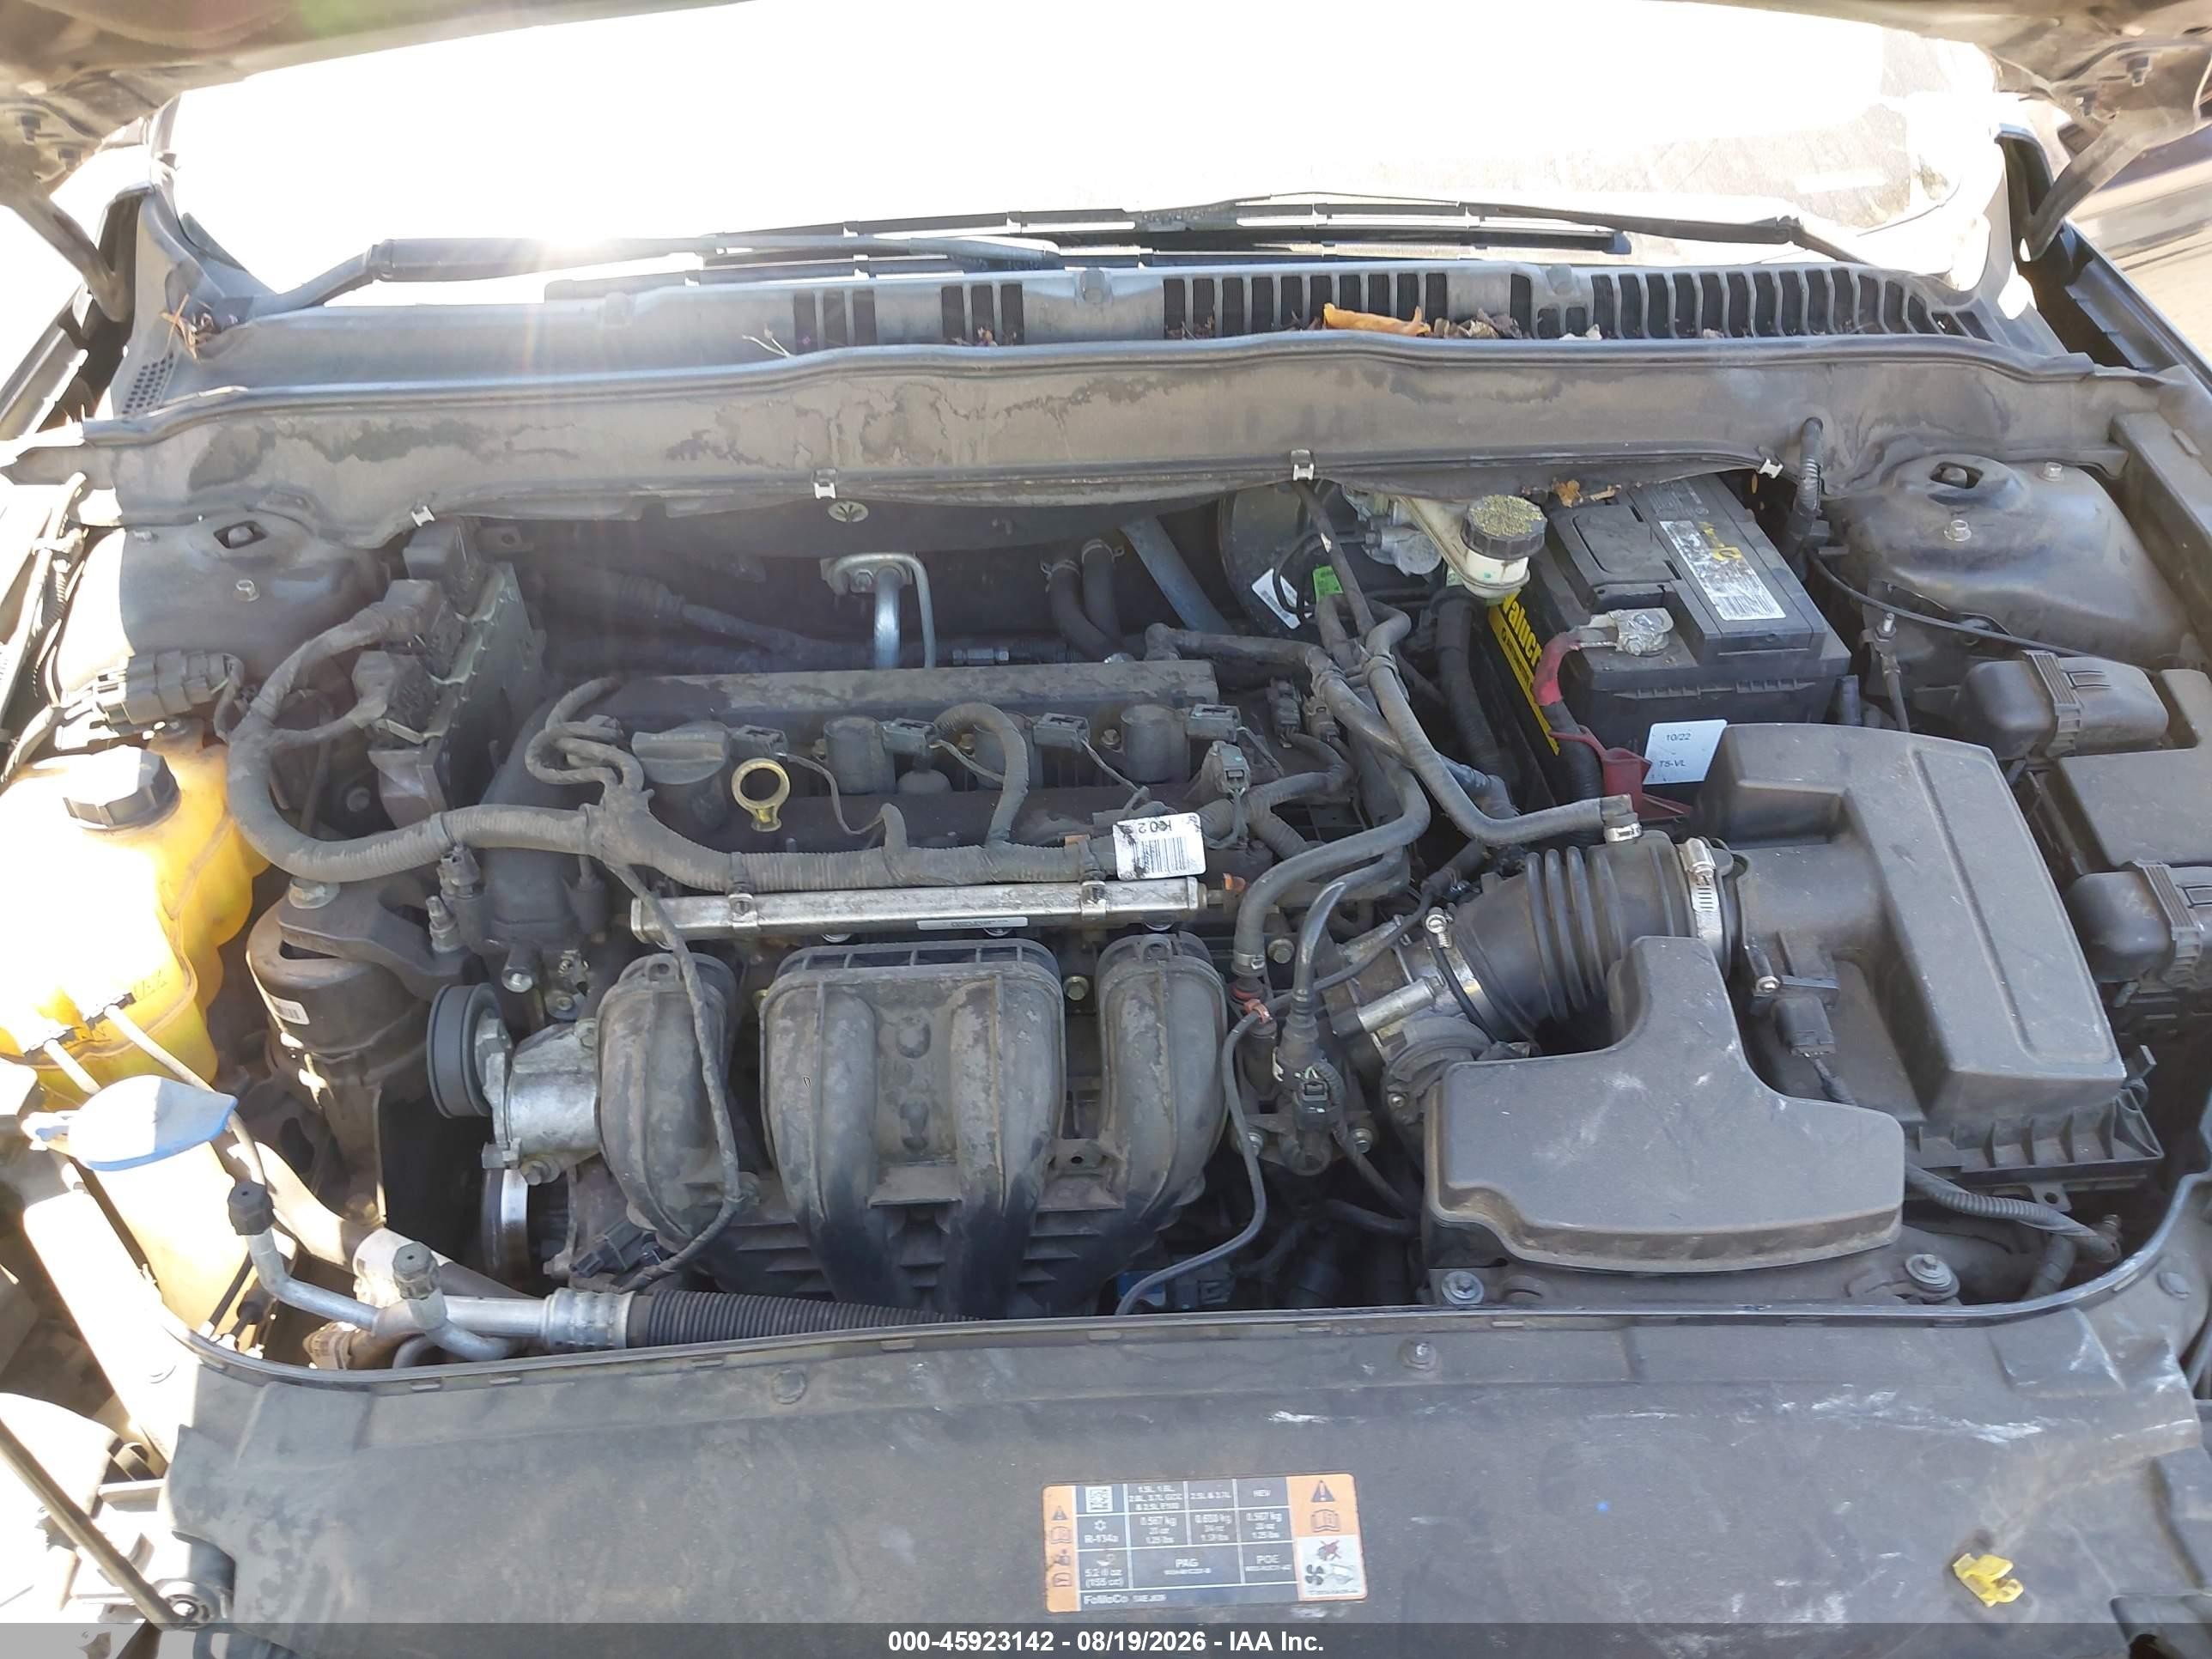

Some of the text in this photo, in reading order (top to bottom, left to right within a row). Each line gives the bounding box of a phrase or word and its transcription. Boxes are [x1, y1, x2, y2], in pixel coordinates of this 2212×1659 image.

[1666, 732, 1692, 742] 10/22
[1085, 1534, 1120, 1544] R-134a
[1175, 1558, 1199, 1568] PAG
[1257, 1553, 1280, 1565] POE
[1084, 1594, 1129, 1605] FoMoCo
